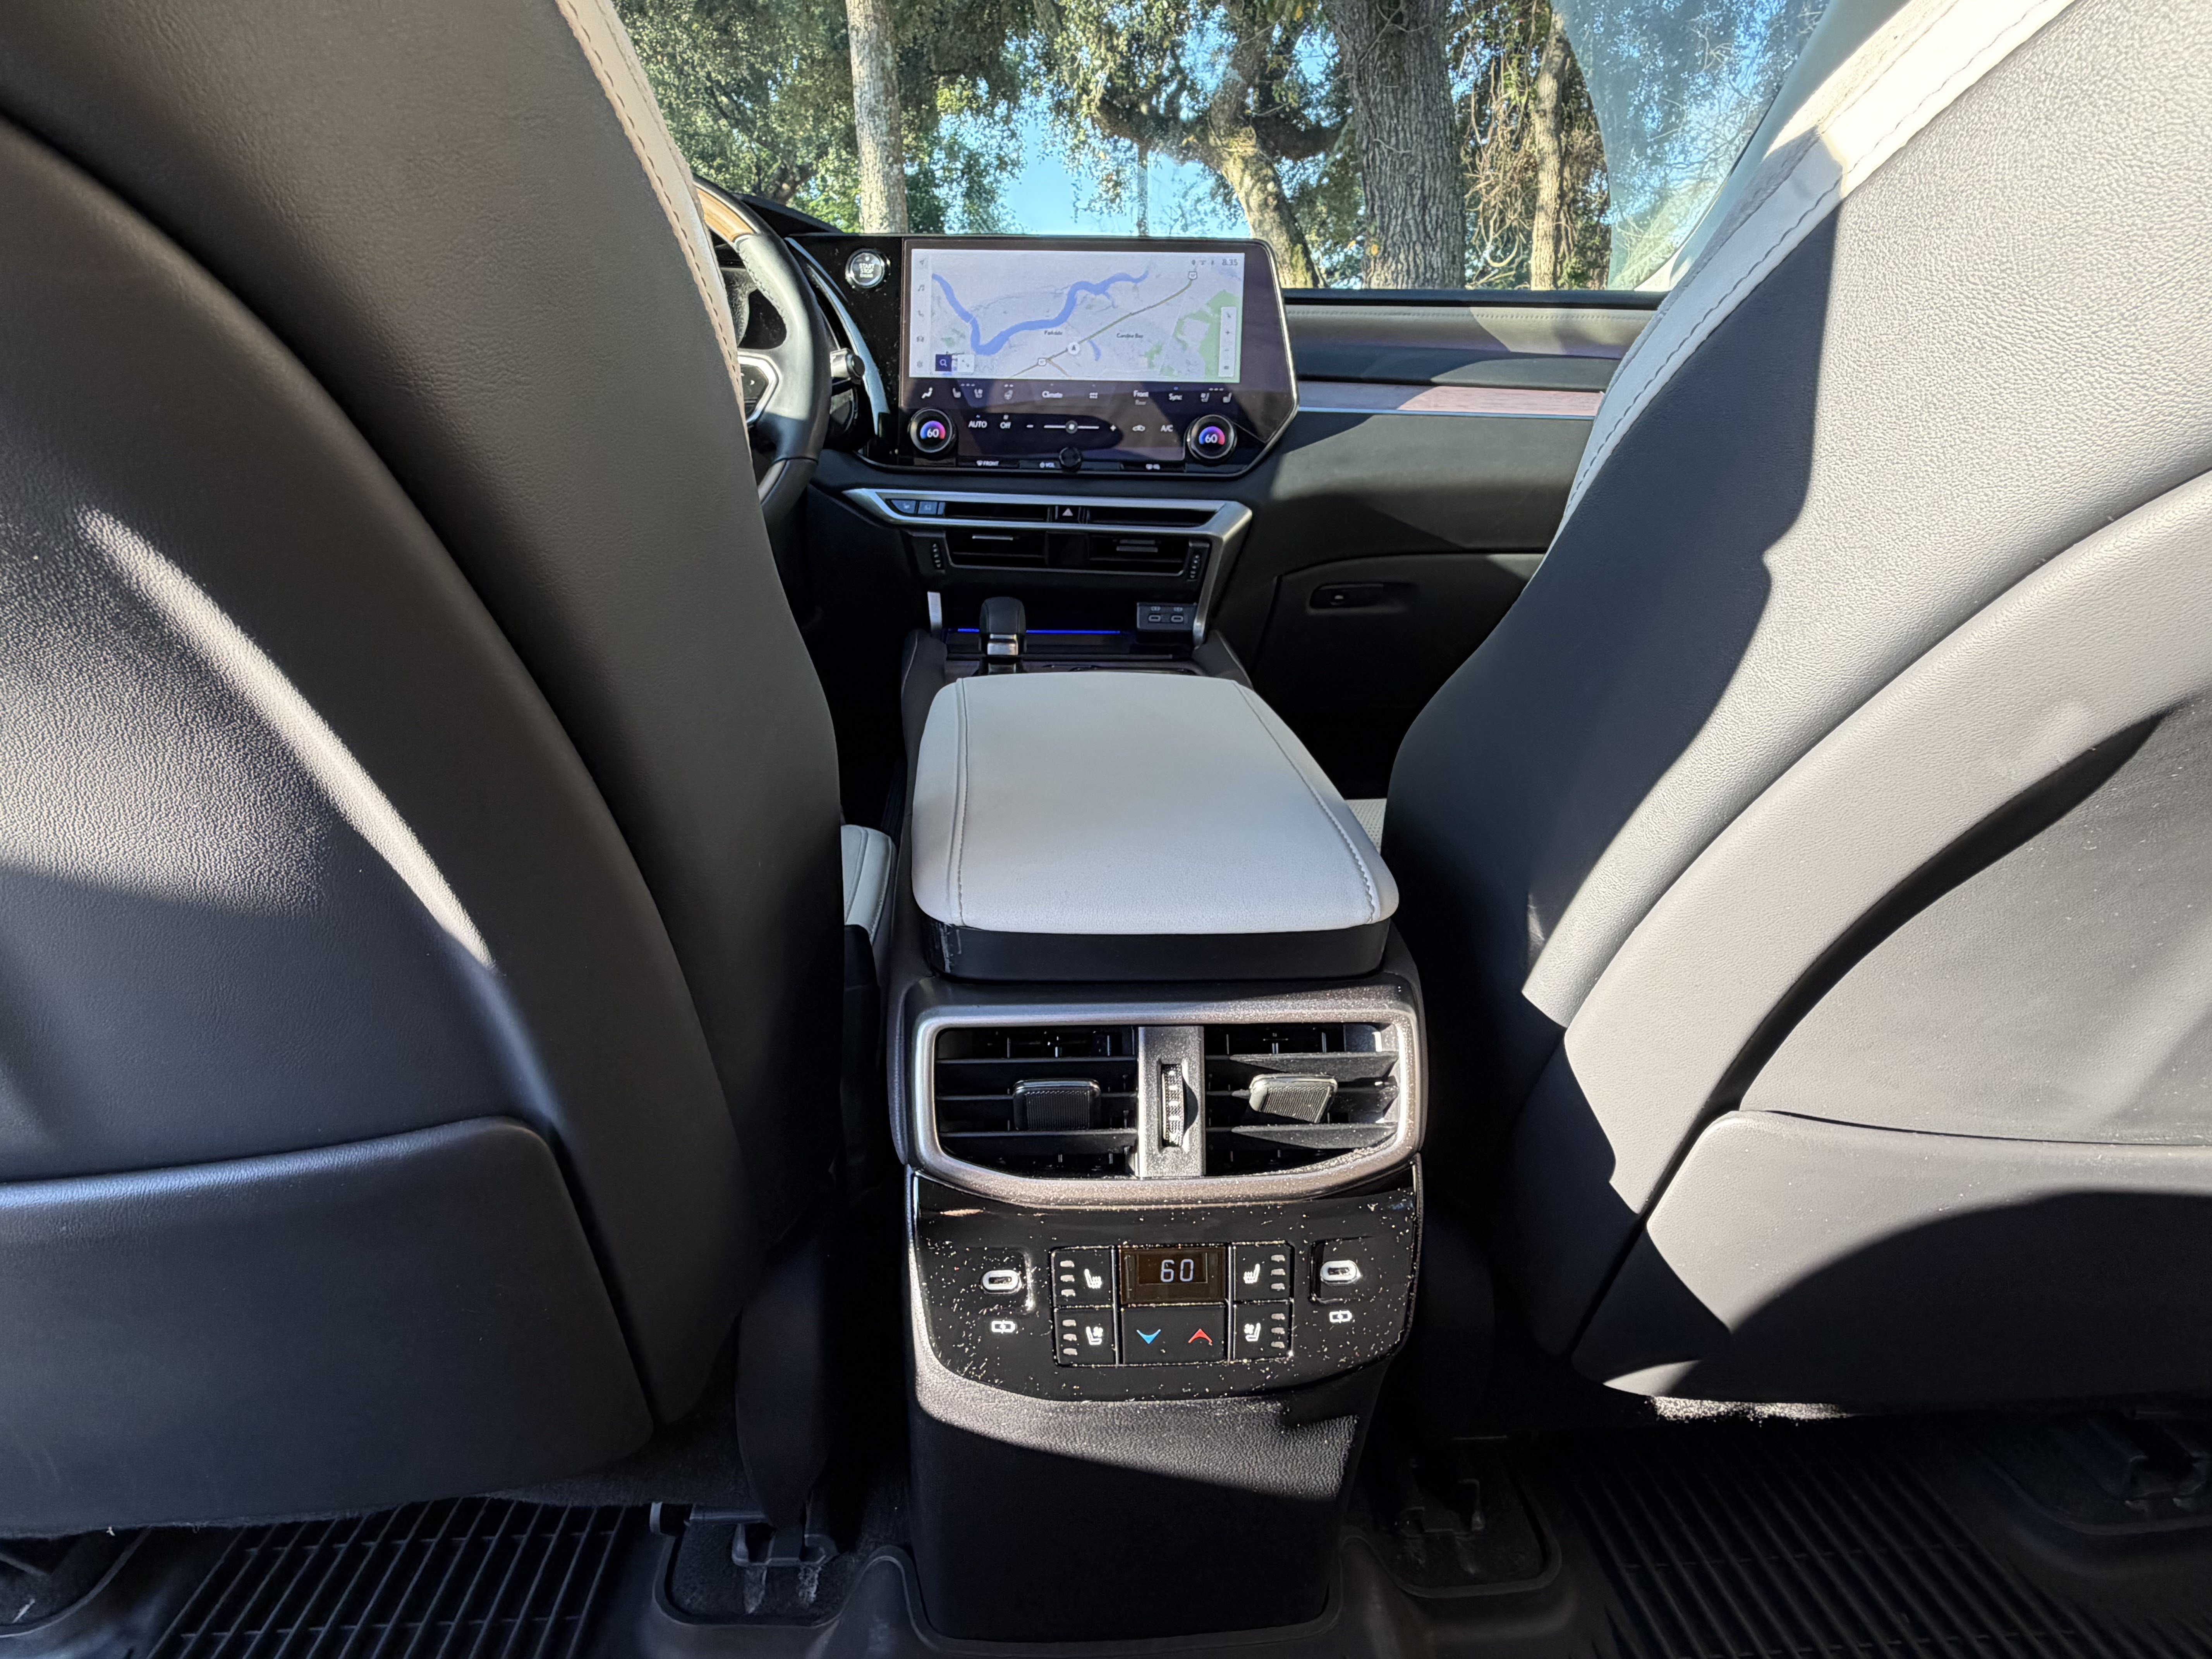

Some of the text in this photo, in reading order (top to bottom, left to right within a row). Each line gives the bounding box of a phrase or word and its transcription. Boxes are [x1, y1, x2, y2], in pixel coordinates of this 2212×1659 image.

[927, 428, 939, 438] 60
[1205, 434, 1218, 443] 60
[1161, 1259, 1194, 1282] 60
